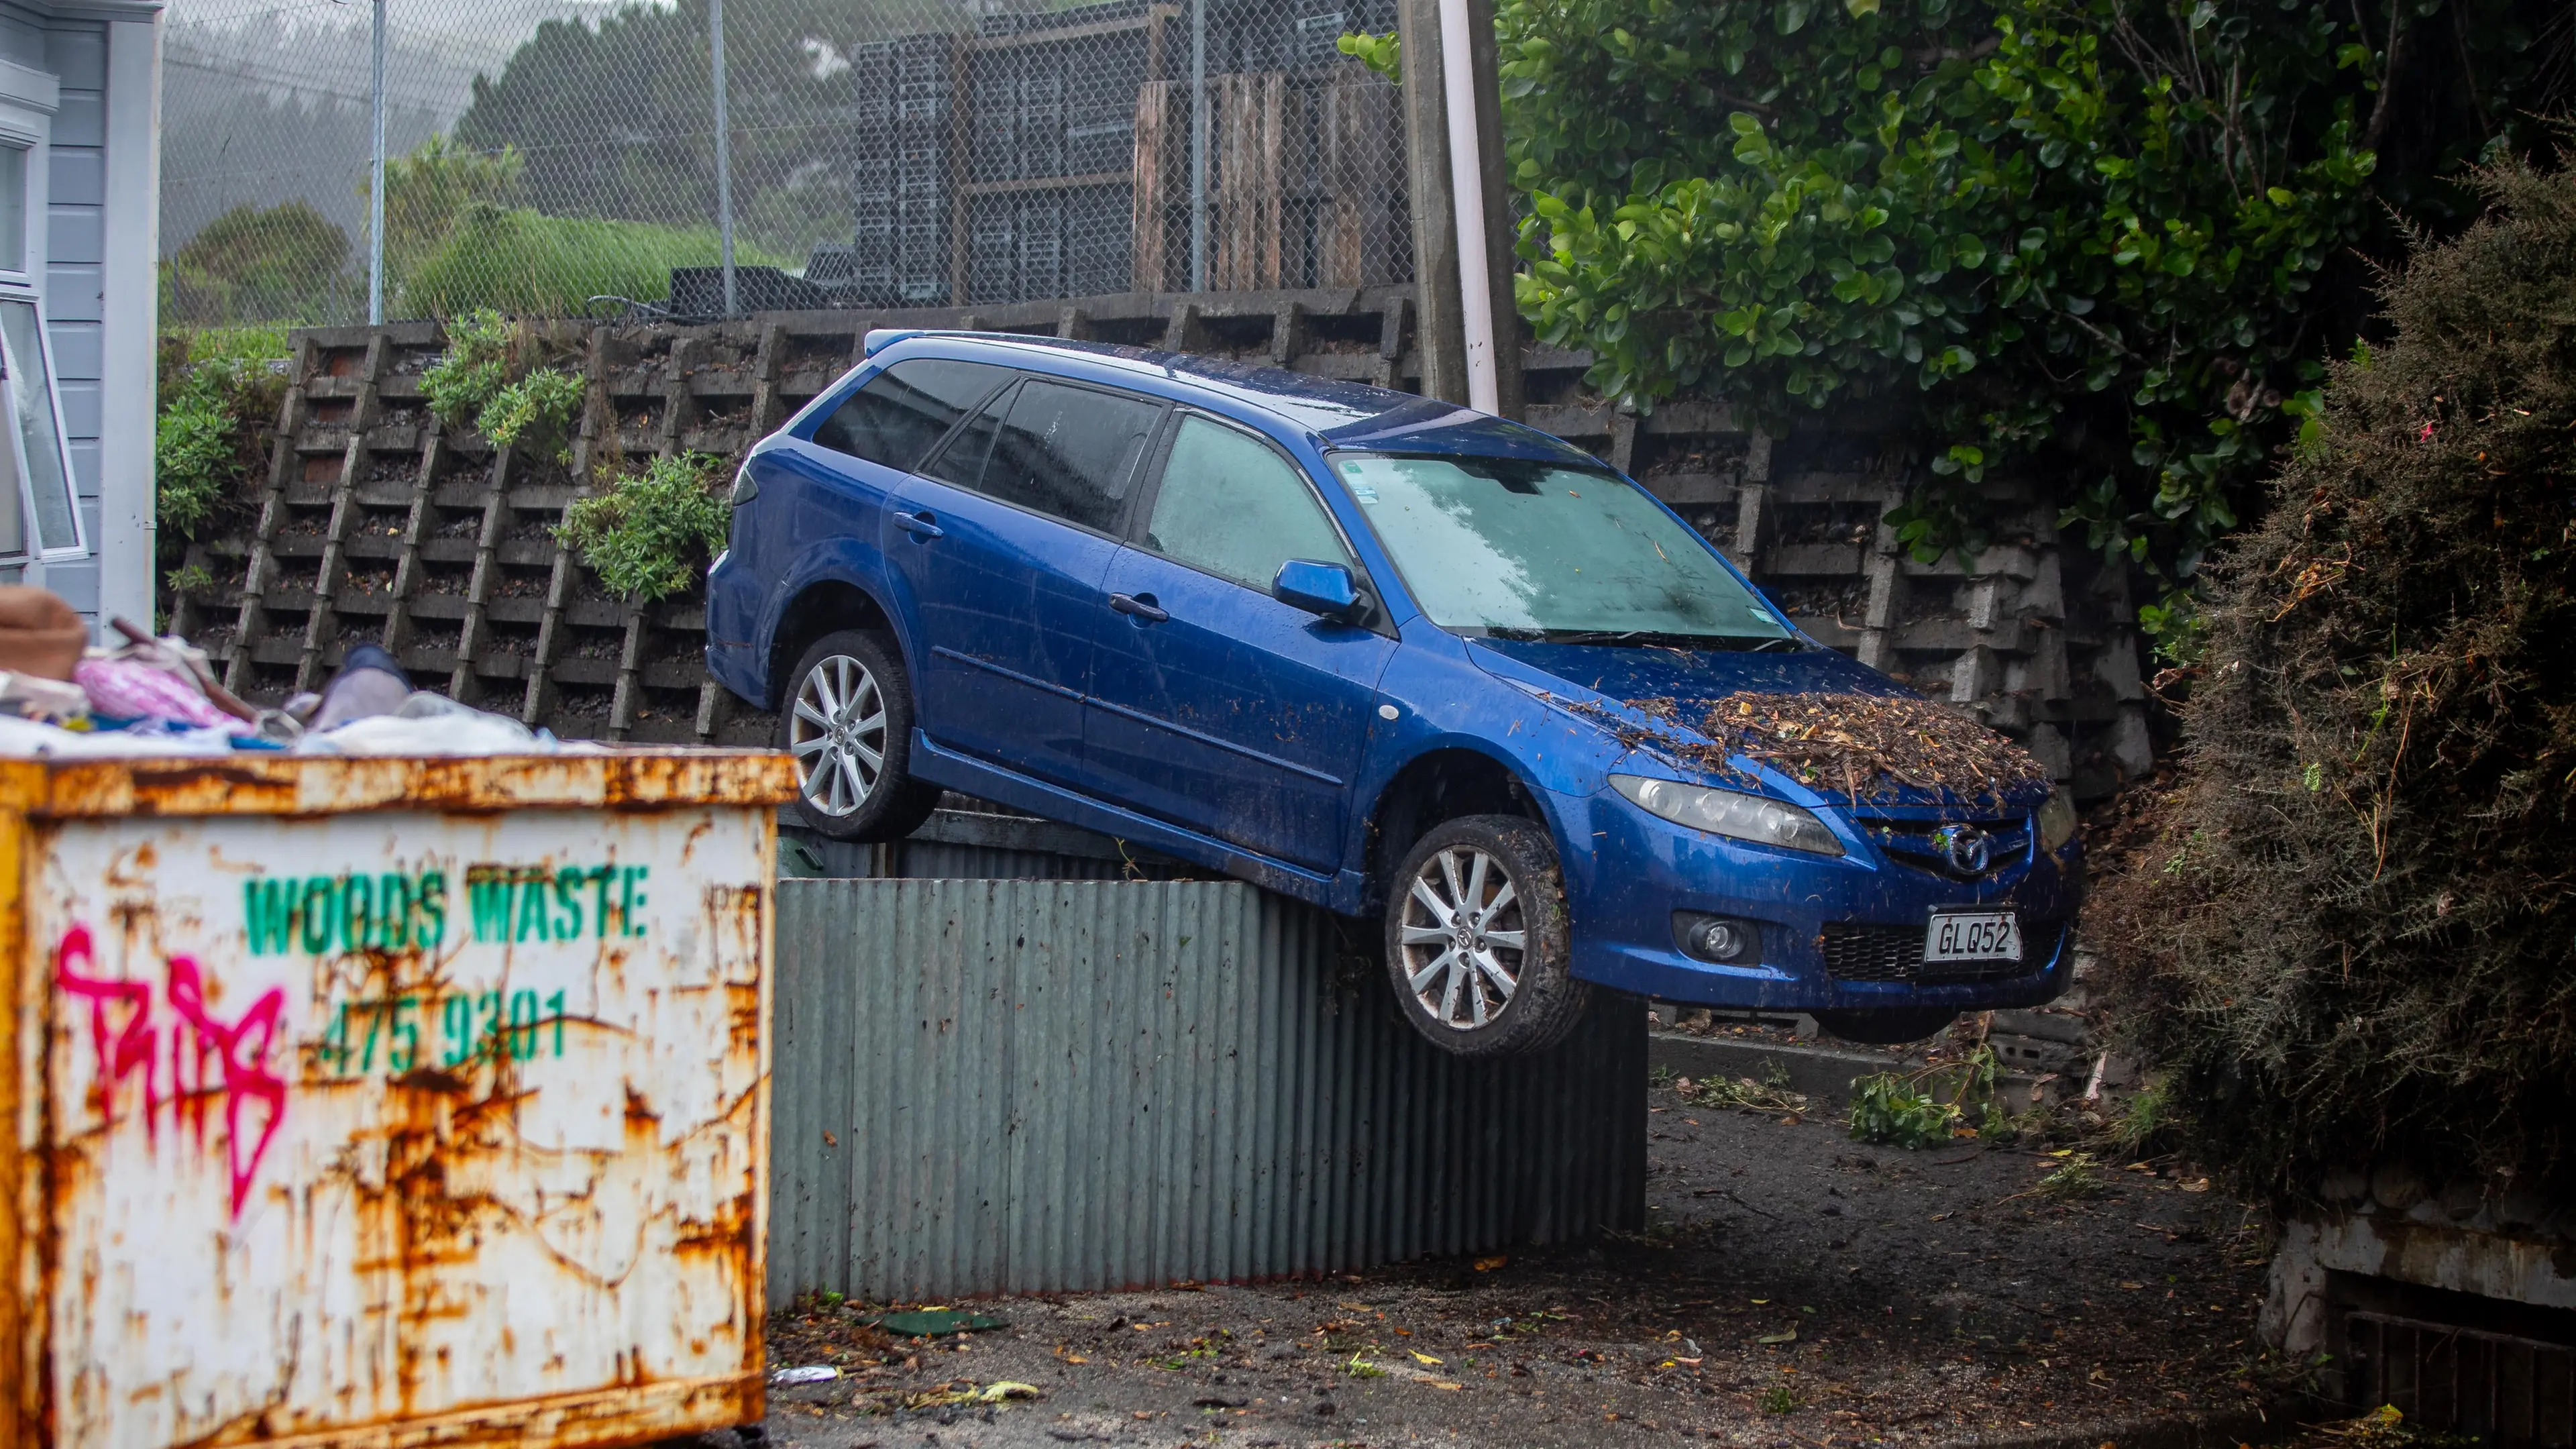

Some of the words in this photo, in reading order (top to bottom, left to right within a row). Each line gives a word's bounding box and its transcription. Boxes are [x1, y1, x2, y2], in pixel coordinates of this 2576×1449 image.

[245, 873, 445, 955] WOODS
[468, 864, 648, 943] WASTE
[322, 996, 419, 1073] 475
[443, 987, 566, 1068] 9301
